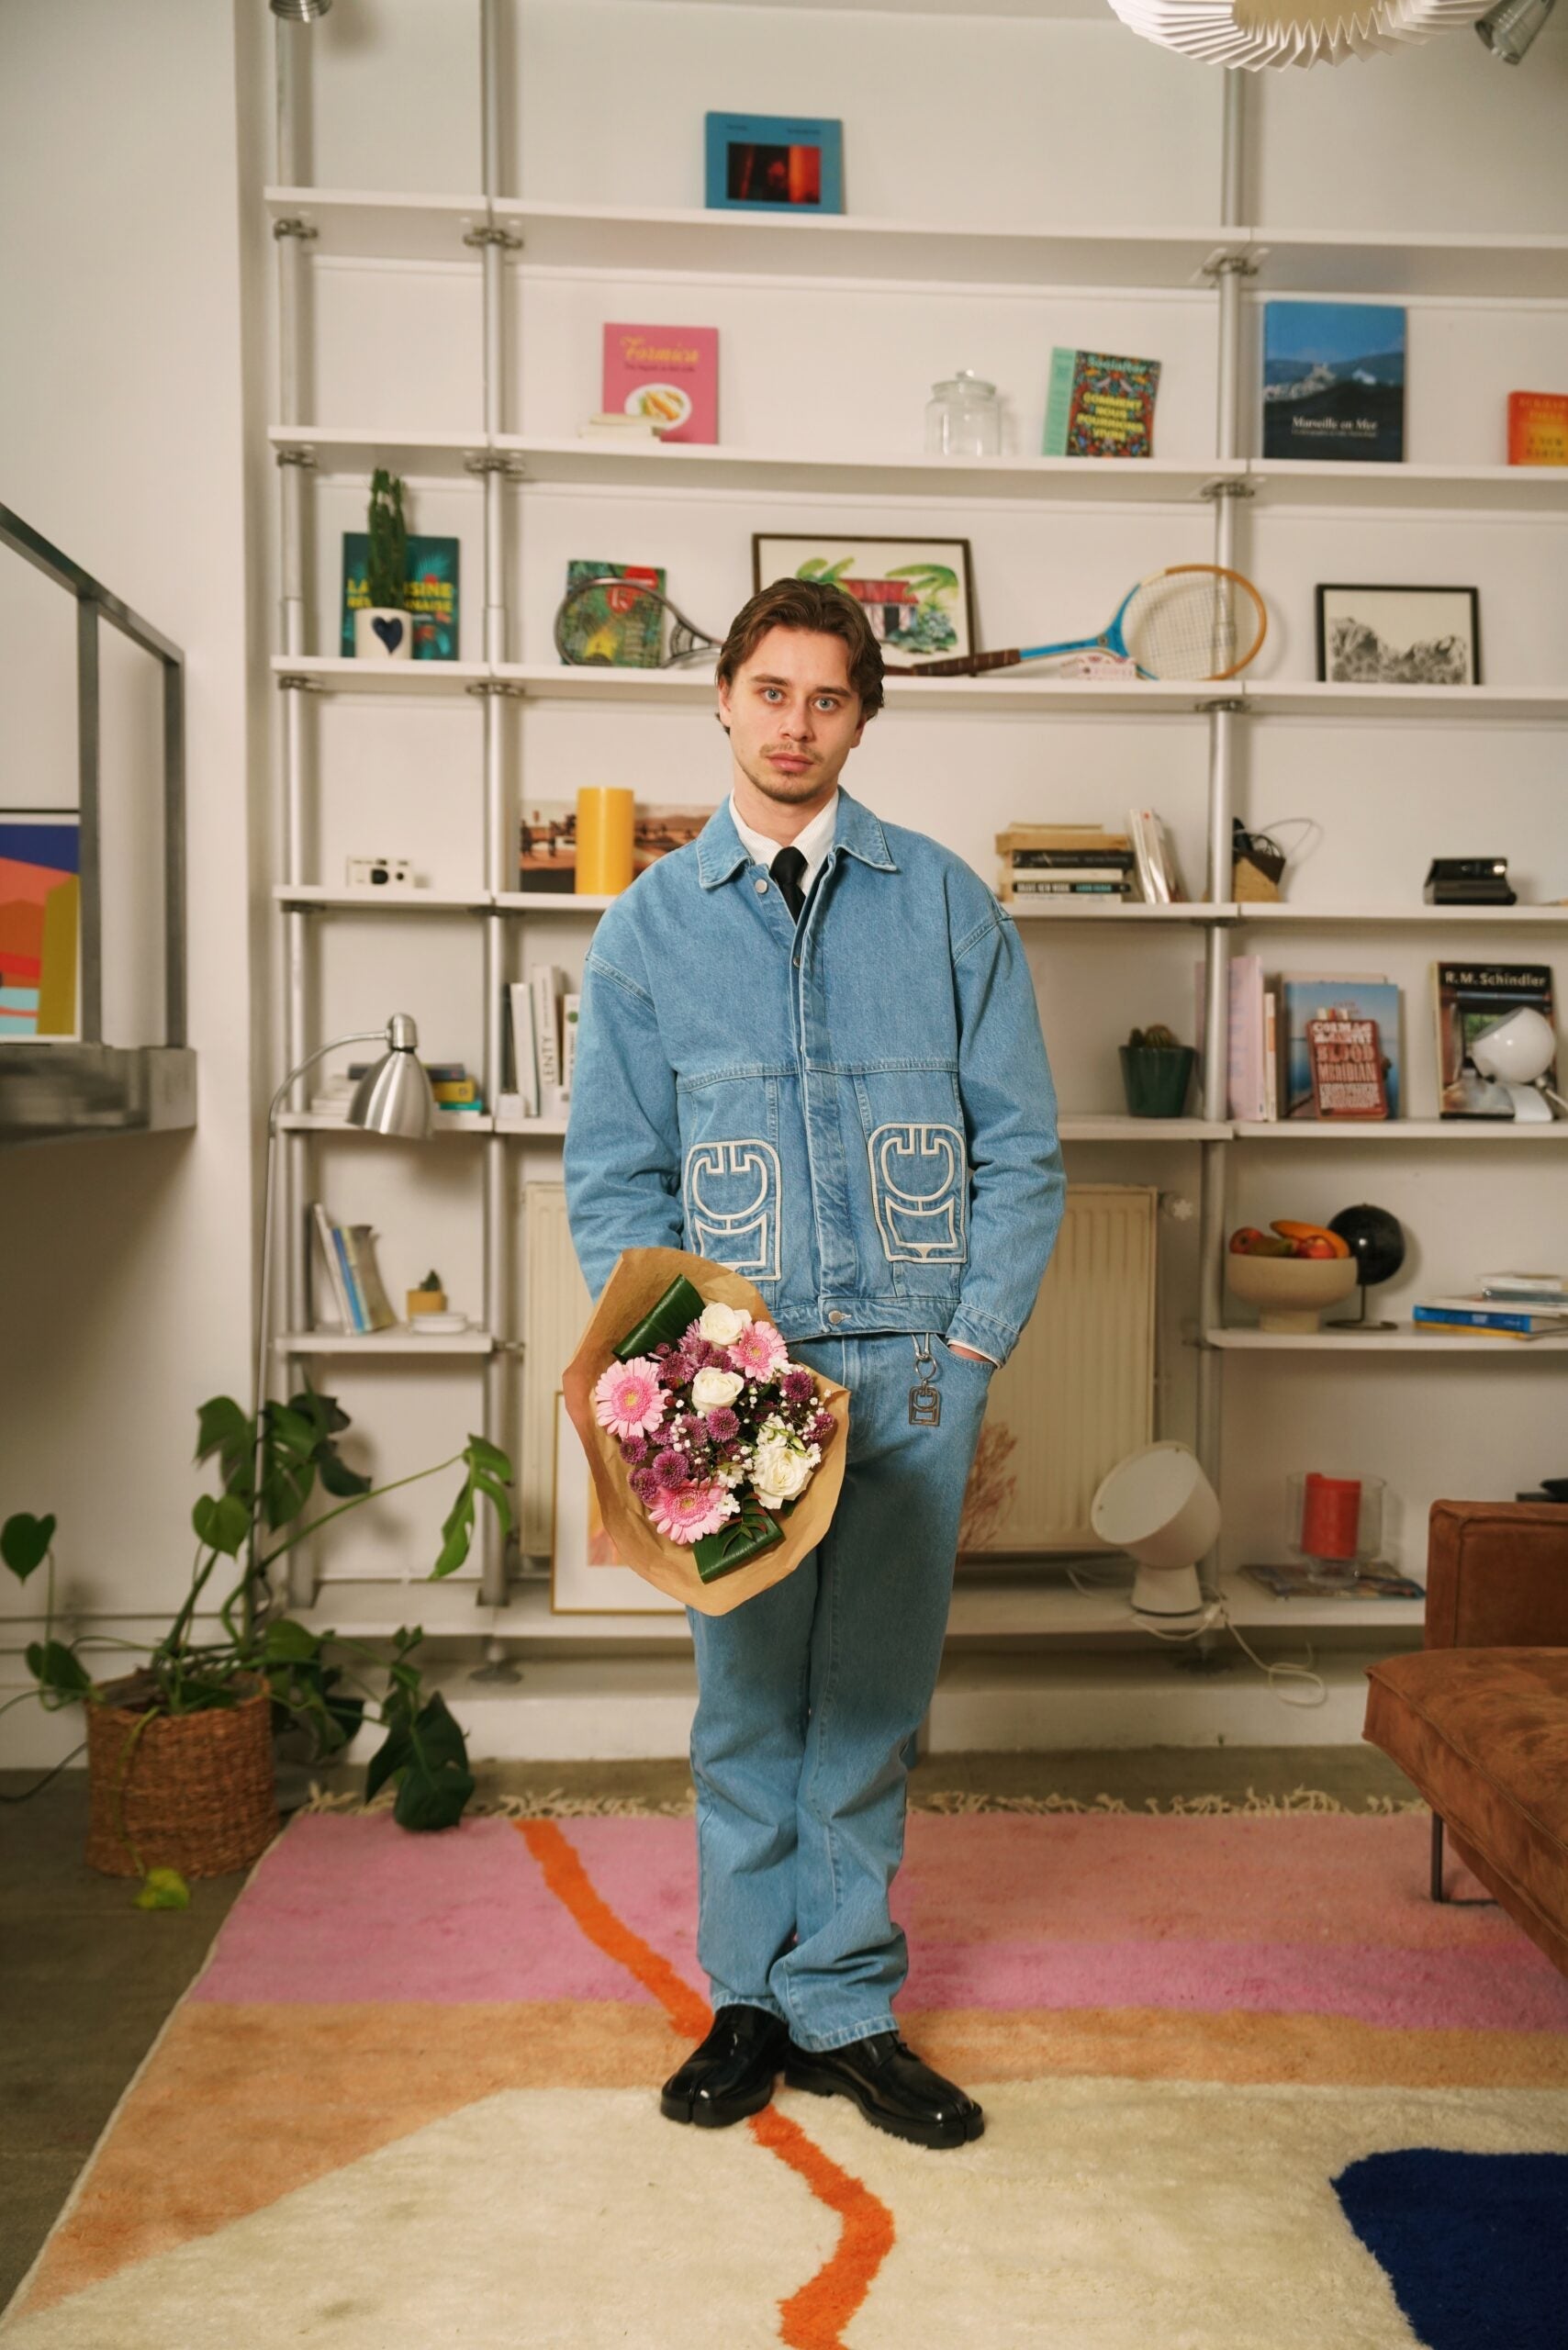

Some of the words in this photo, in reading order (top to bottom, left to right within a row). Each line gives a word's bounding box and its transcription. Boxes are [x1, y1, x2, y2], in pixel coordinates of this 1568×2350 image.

[1293, 416, 1338, 430] Marseille
[1356, 418, 1377, 431] Mer
[1480, 972, 1547, 988] Schindler
[1316, 1046, 1374, 1063] BLOOD
